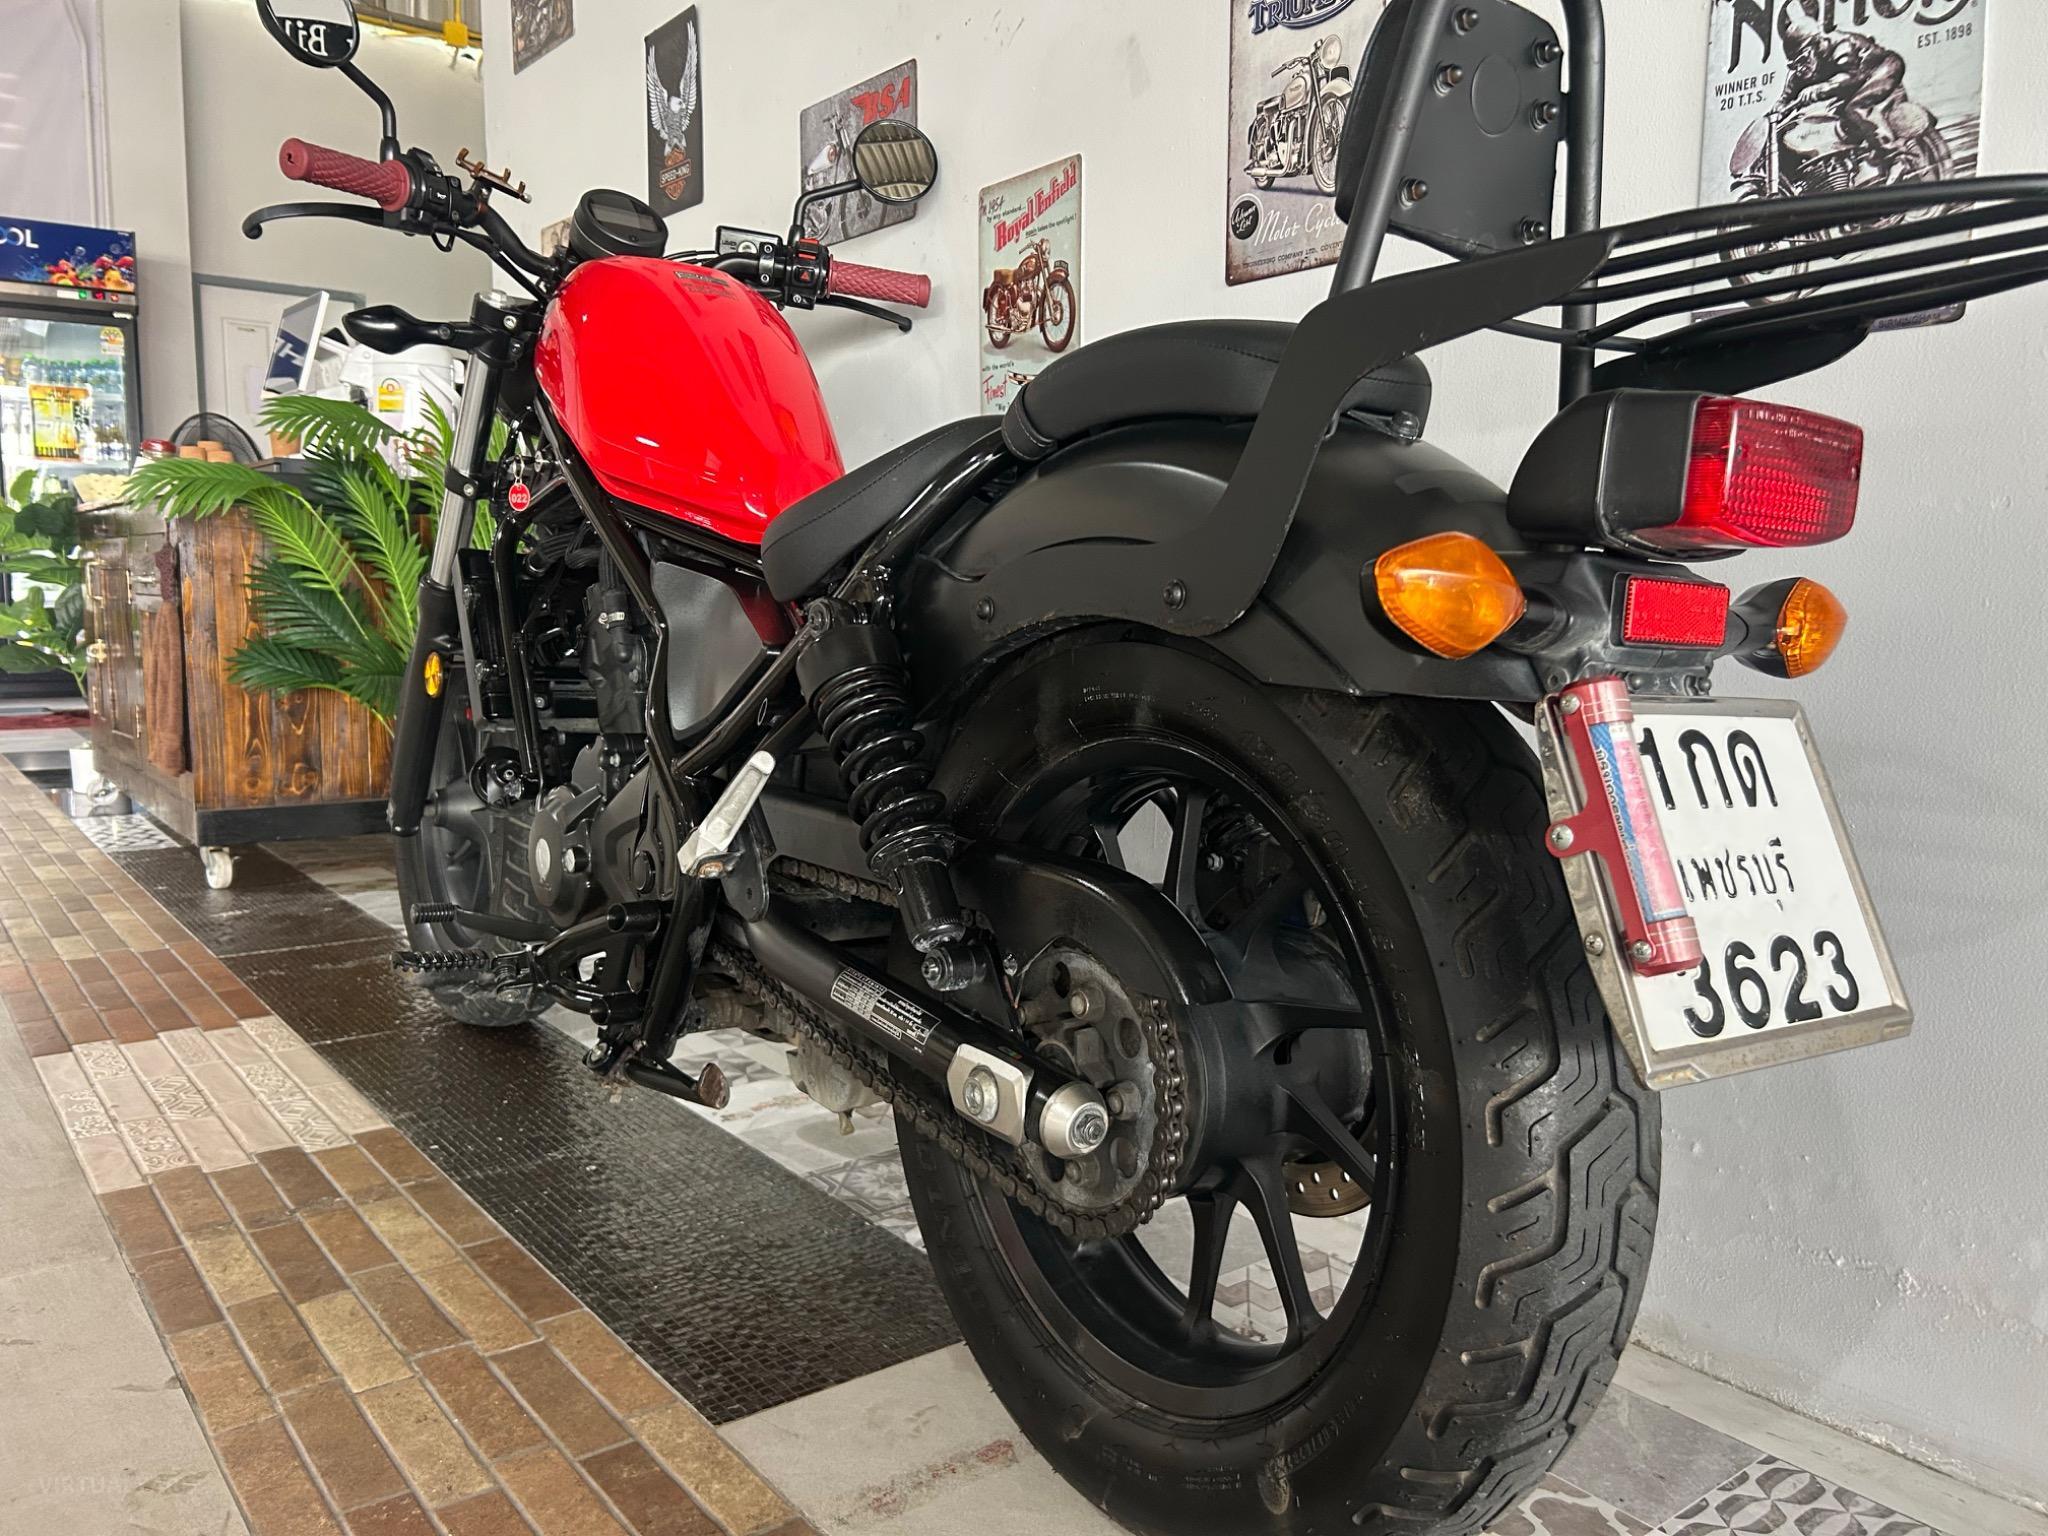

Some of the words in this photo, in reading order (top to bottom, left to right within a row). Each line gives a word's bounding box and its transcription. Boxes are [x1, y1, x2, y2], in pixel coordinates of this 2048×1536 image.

[1917, 31, 1941, 48] EST.
[1945, 23, 1973, 41] 1898
[1714, 77, 1758, 97] WINNER
[1761, 71, 1776, 86] OF
[851, 76, 910, 126] BSA
[1720, 98, 1734, 111] 20
[1738, 90, 1766, 108] T.T.S.
[994, 195, 1035, 252] Royal
[1034, 160, 1077, 217] Enfield
[1254, 208, 1301, 247] Motor
[511, 493, 528, 504] 022
[1683, 929, 1860, 1040] 3623
